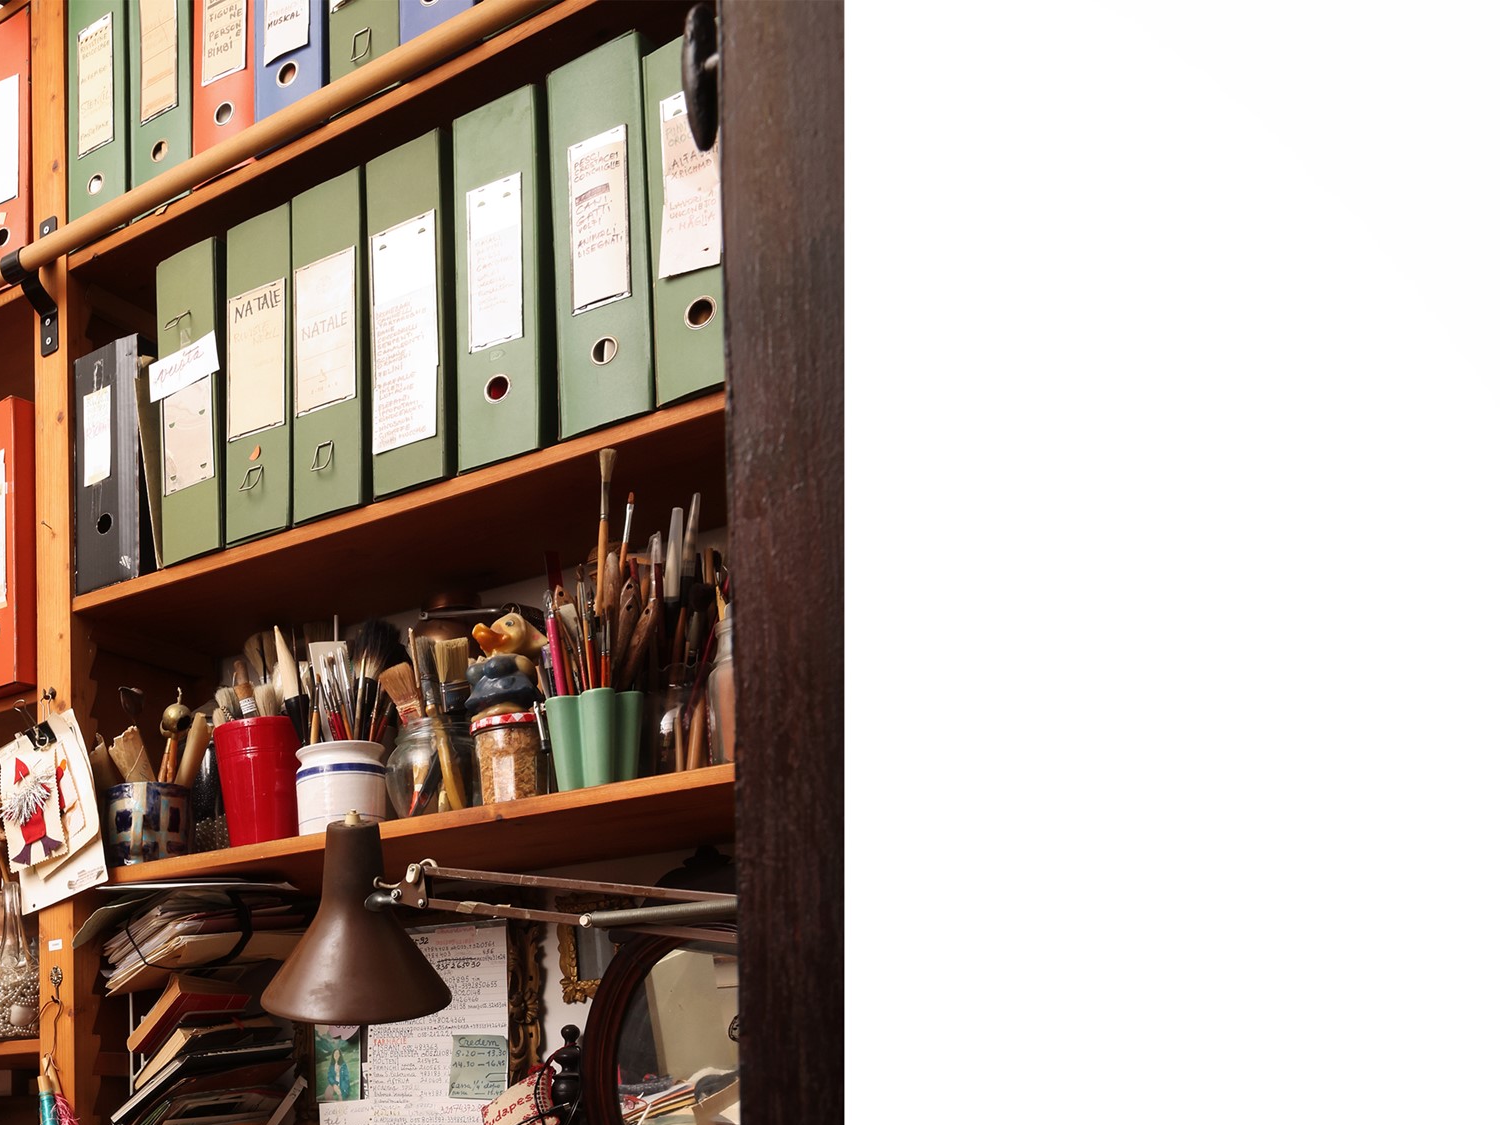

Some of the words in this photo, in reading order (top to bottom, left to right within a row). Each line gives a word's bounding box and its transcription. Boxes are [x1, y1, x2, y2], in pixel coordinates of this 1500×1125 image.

[234, 288, 282, 325] NATALE
[301, 310, 349, 342] NATALE
[458, 1036, 499, 1047] Credem
